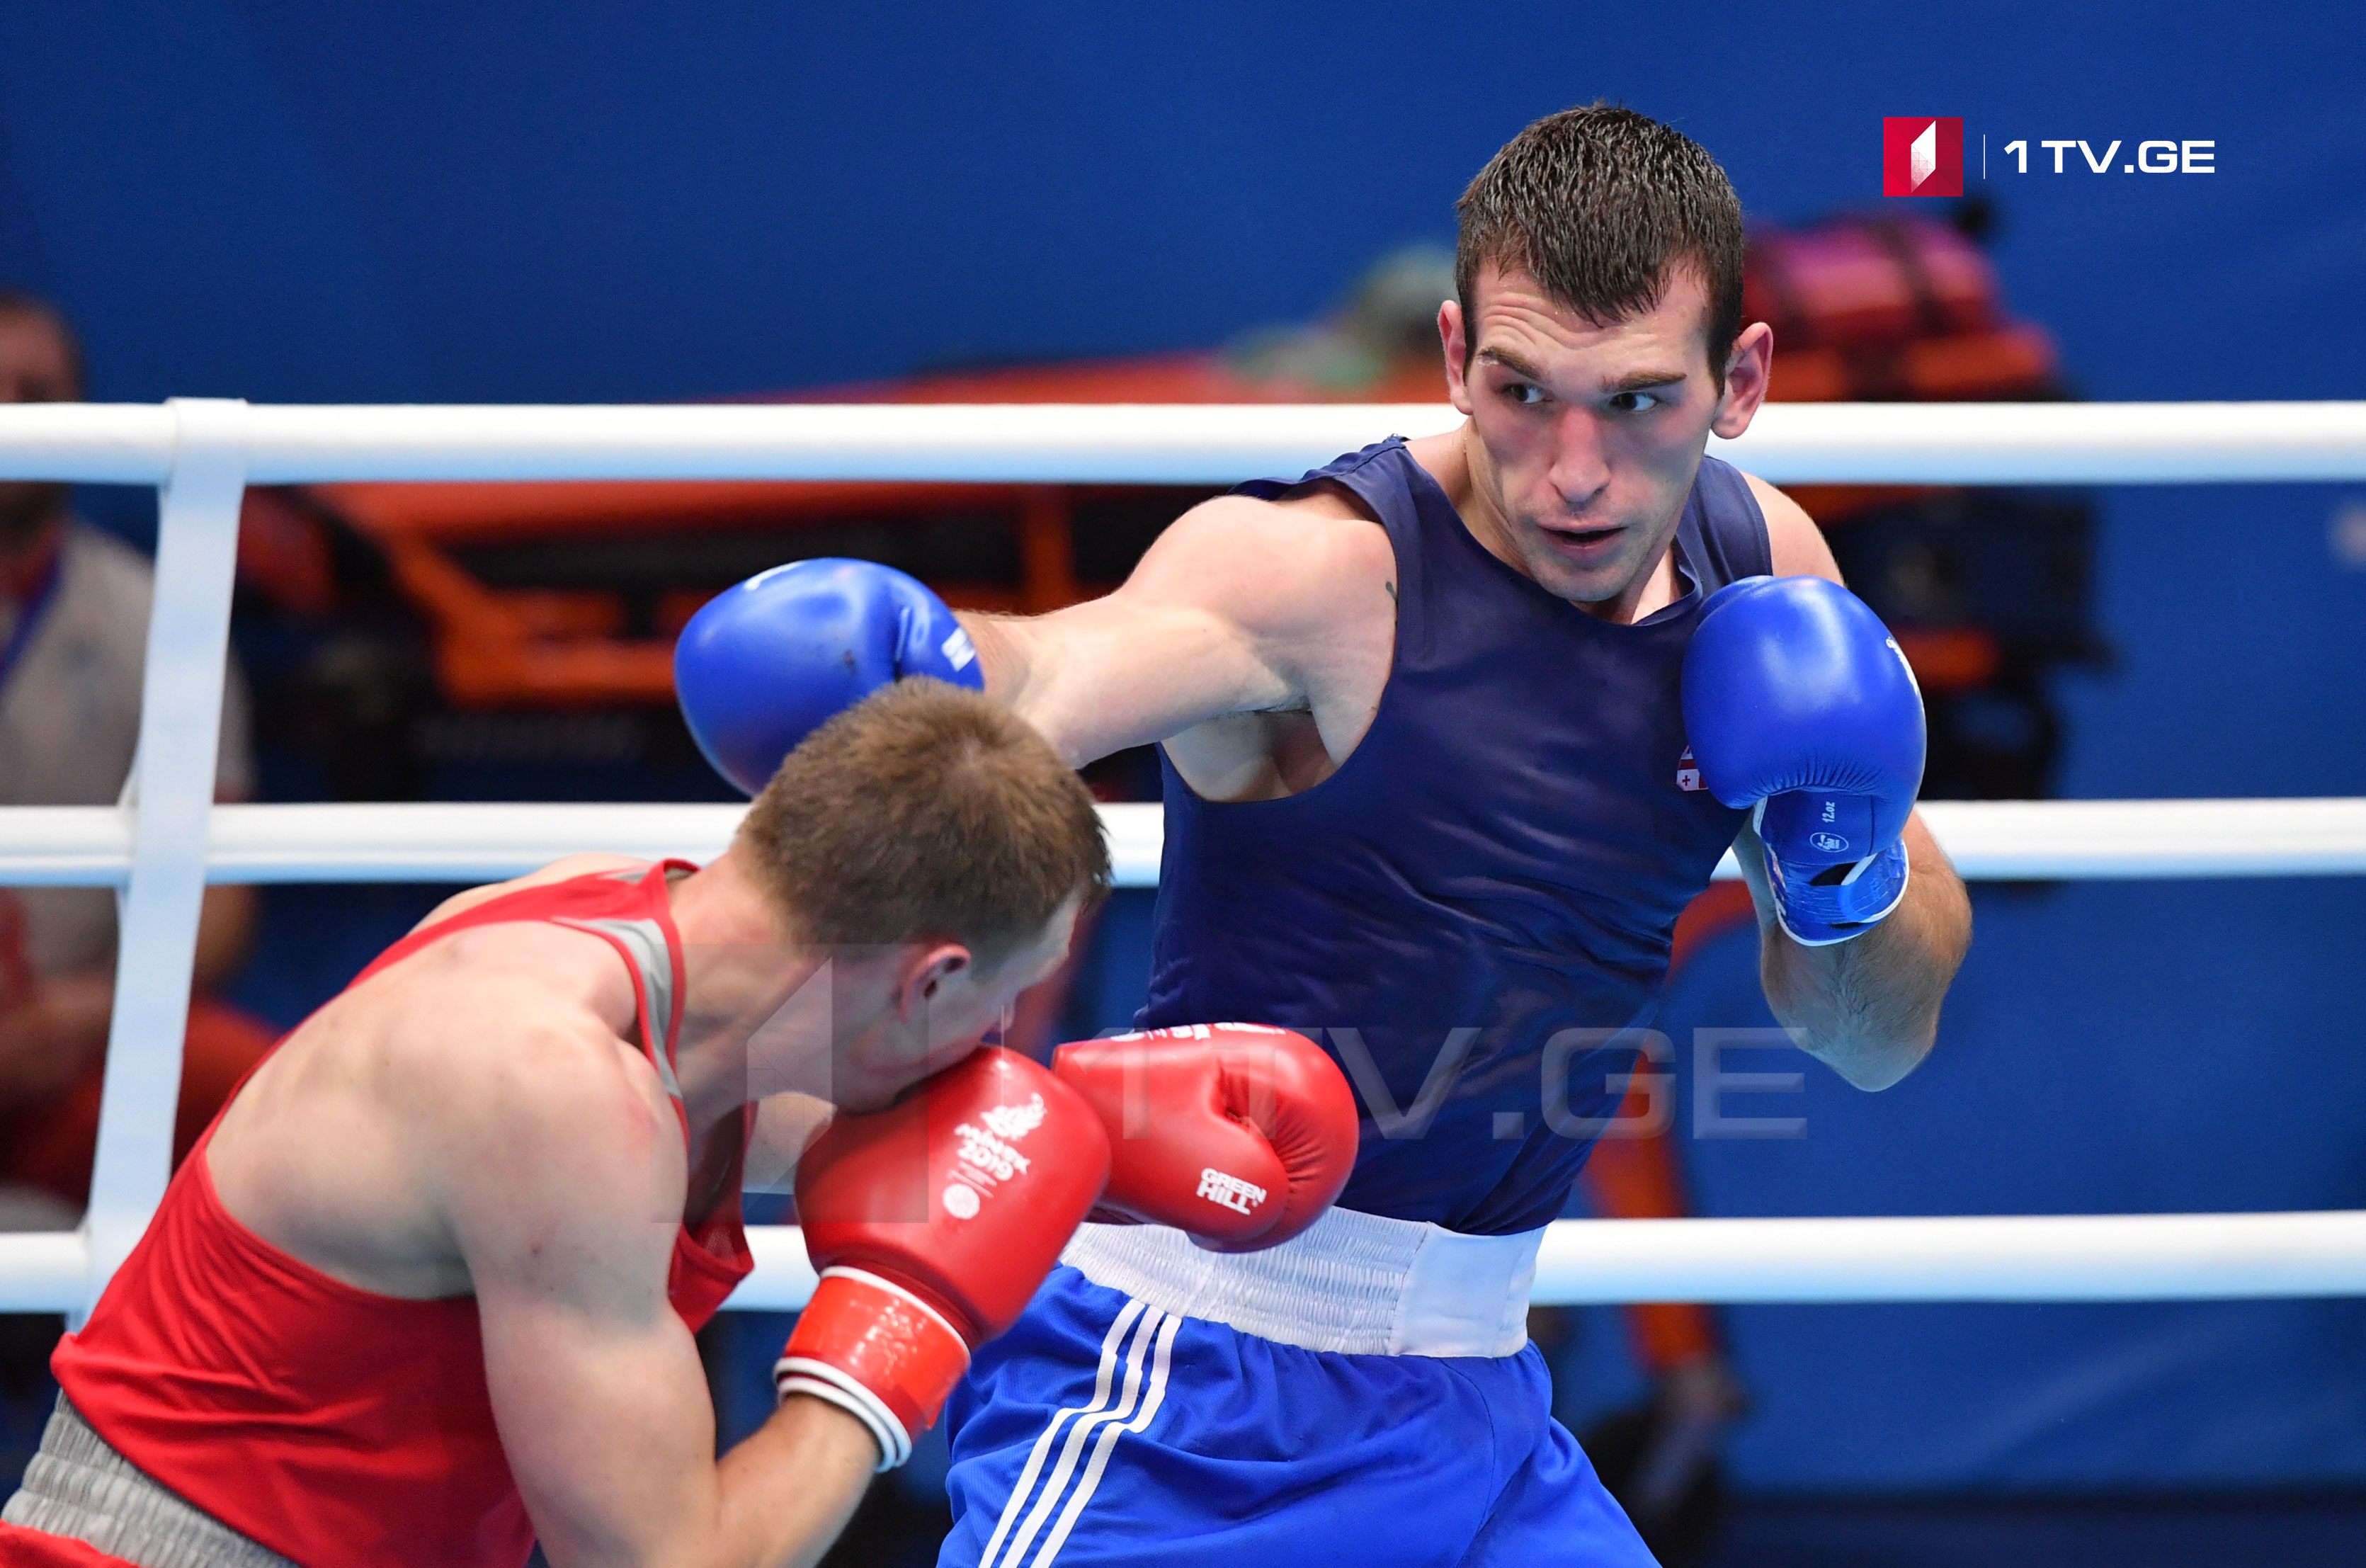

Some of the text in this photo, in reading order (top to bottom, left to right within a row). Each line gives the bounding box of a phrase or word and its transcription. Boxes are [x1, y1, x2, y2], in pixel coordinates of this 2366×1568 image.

[957, 1139, 1014, 1182] 2019
[1196, 1179, 1251, 1215] HILL
[1201, 1168, 1268, 1205] GREEN
